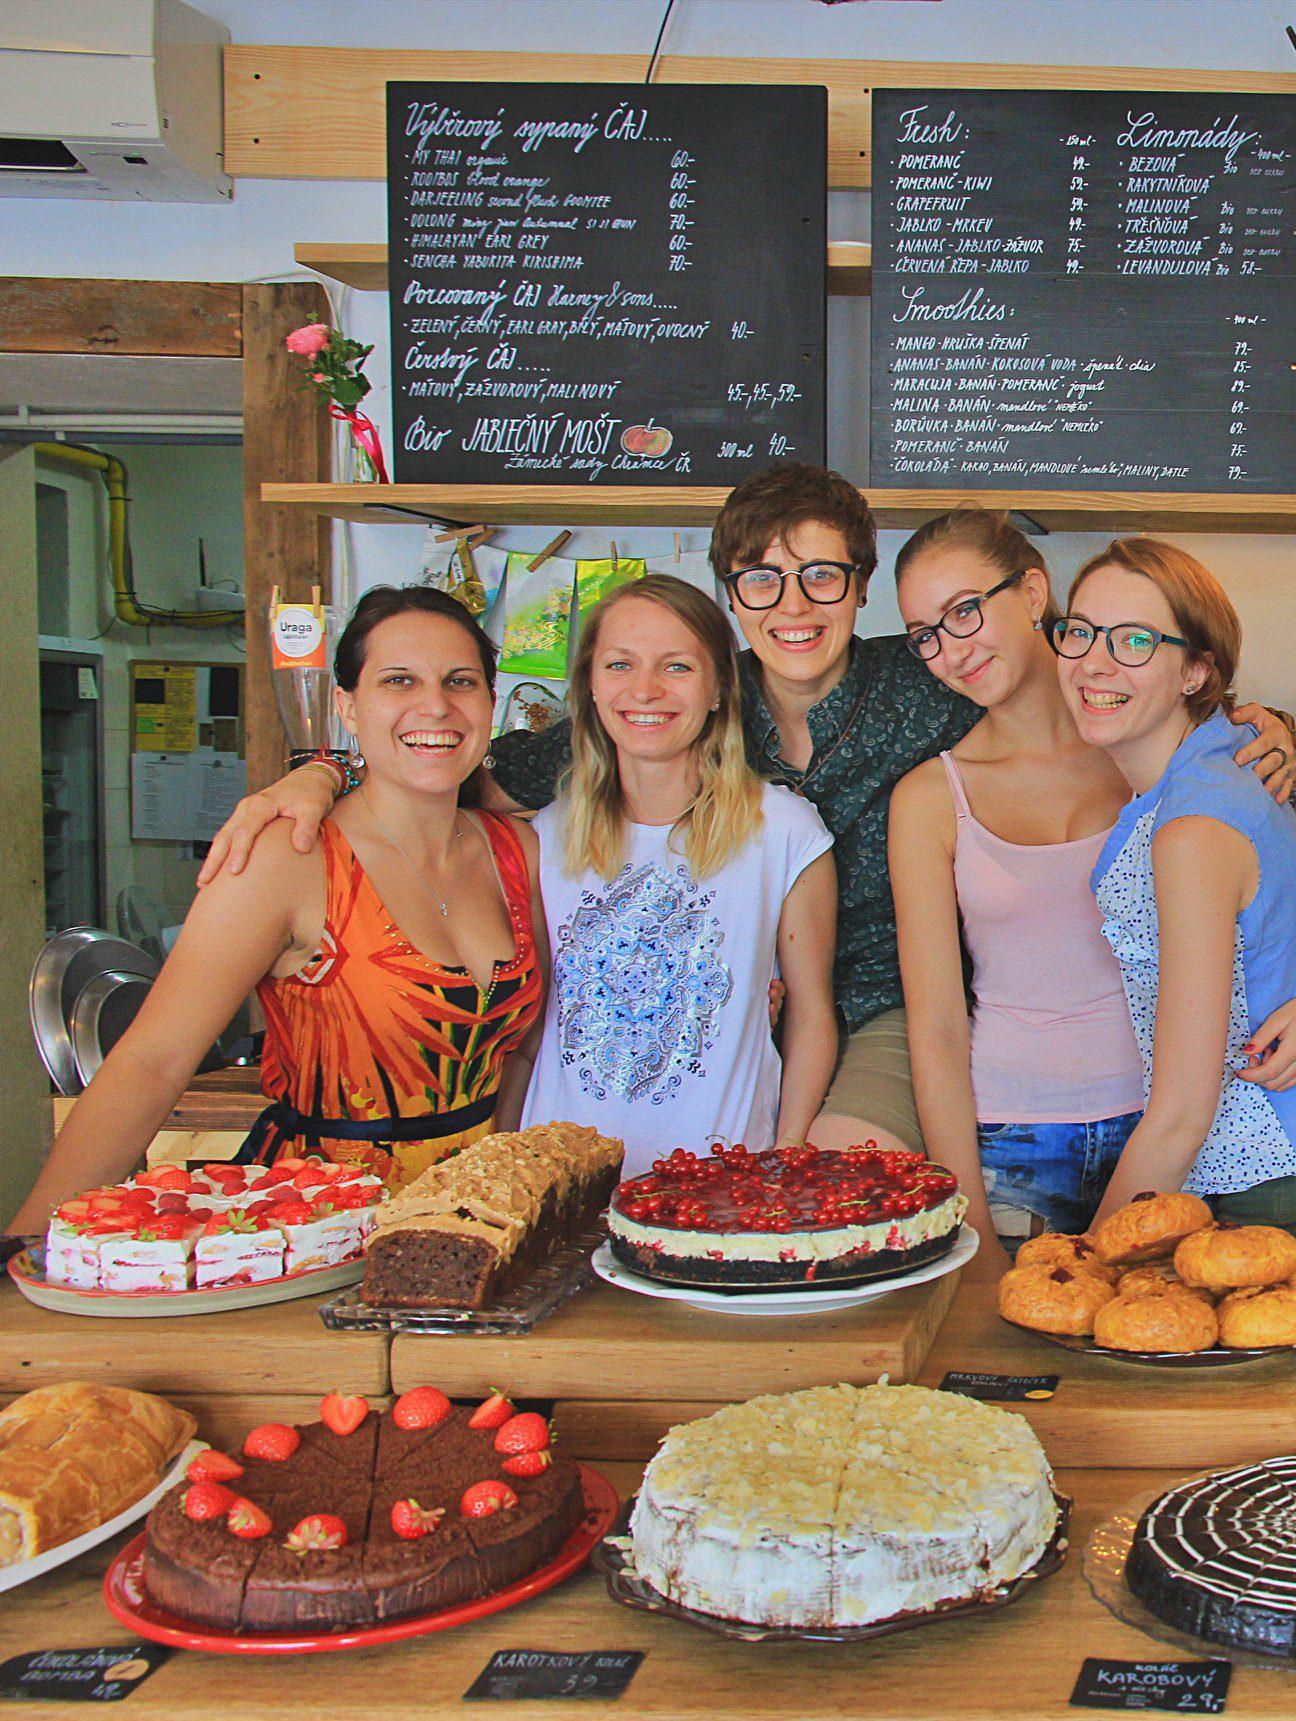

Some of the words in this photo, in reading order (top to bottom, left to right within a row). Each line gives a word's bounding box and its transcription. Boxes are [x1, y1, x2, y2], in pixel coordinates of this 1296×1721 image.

[513, 112, 598, 153] sypaný
[411, 149, 430, 165] MY
[434, 149, 462, 165] THAI
[410, 172, 460, 187] ROOIBOS
[410, 190, 485, 207] DARJEELING
[895, 196, 972, 211] GRAPEFRUIT
[1125, 196, 1198, 214] MALINOVÁ
[410, 213, 457, 228] OOLONG
[410, 234, 478, 249] HIMALAYAN
[485, 233, 513, 249] EARL
[517, 234, 550, 250] GREY
[410, 254, 458, 269] SENCHA
[462, 254, 517, 269] YABUKITA
[522, 254, 585, 270] KIRISHIMA
[1121, 257, 1219, 276] LEVANDULOVÁ
[403, 414, 453, 451] Bio
[461, 412, 565, 453] JABLEČNÝ
[559, 412, 623, 455] MOŠT
[280, 621, 313, 635] Uraga
[493, 1652, 593, 1668] KAROTKOVÝ
[1096, 1669, 1217, 1688] KAROBOVÝ
